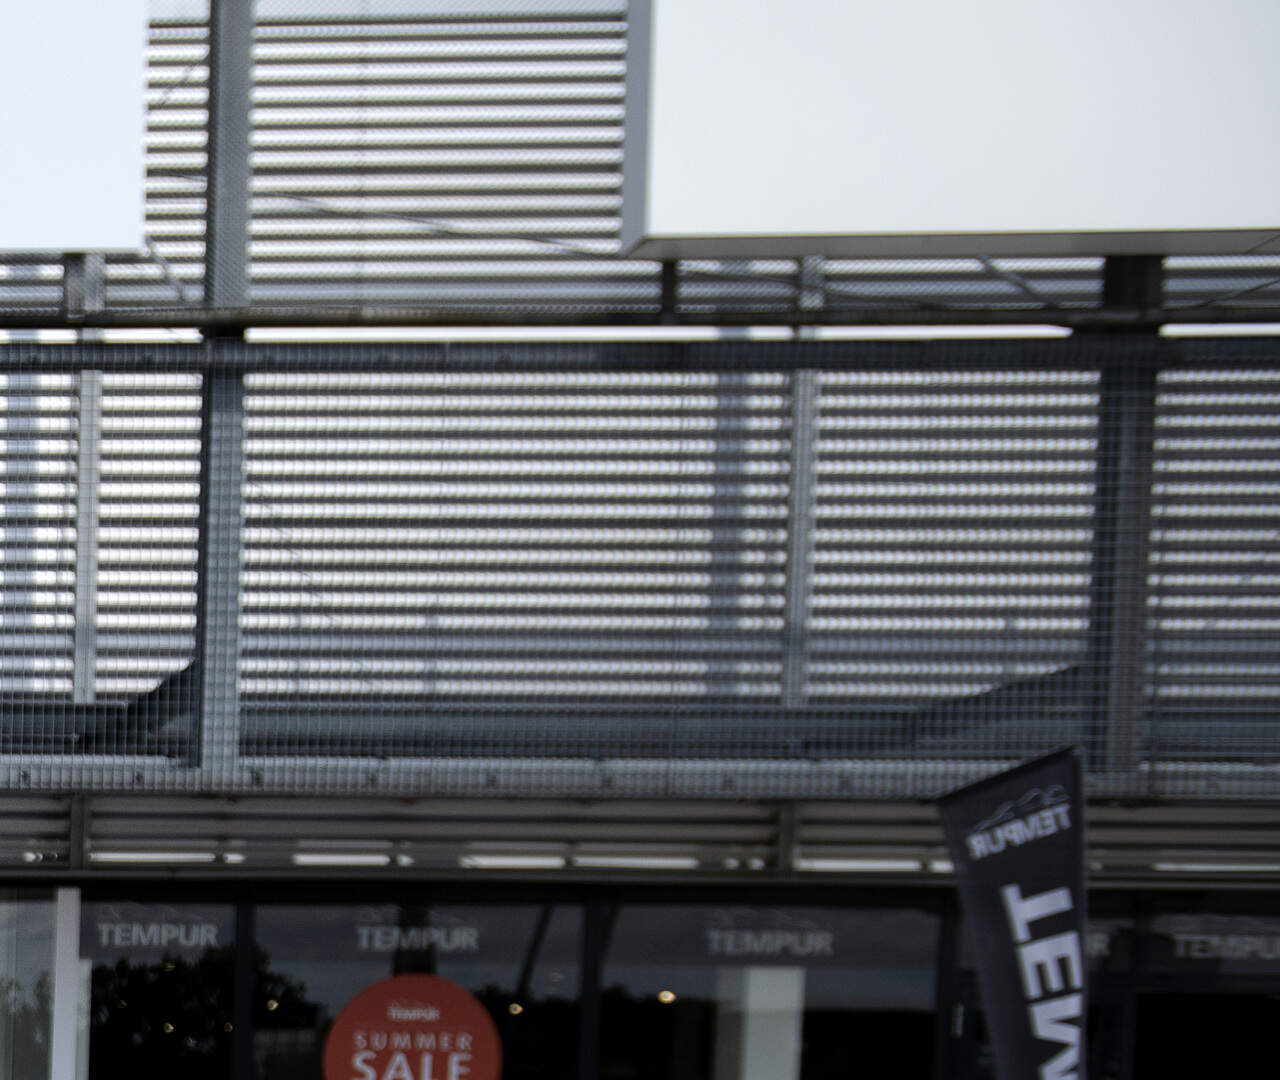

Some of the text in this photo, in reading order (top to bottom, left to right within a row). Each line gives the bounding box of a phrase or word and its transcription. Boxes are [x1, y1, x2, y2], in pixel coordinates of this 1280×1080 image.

[97, 922, 219, 947] TEMPUR
[358, 926, 480, 951] TEMPUR
[709, 929, 834, 956] TEMPUR
[1175, 934, 1280, 960] TEMPU
[353, 1032, 473, 1050] SUMMER
